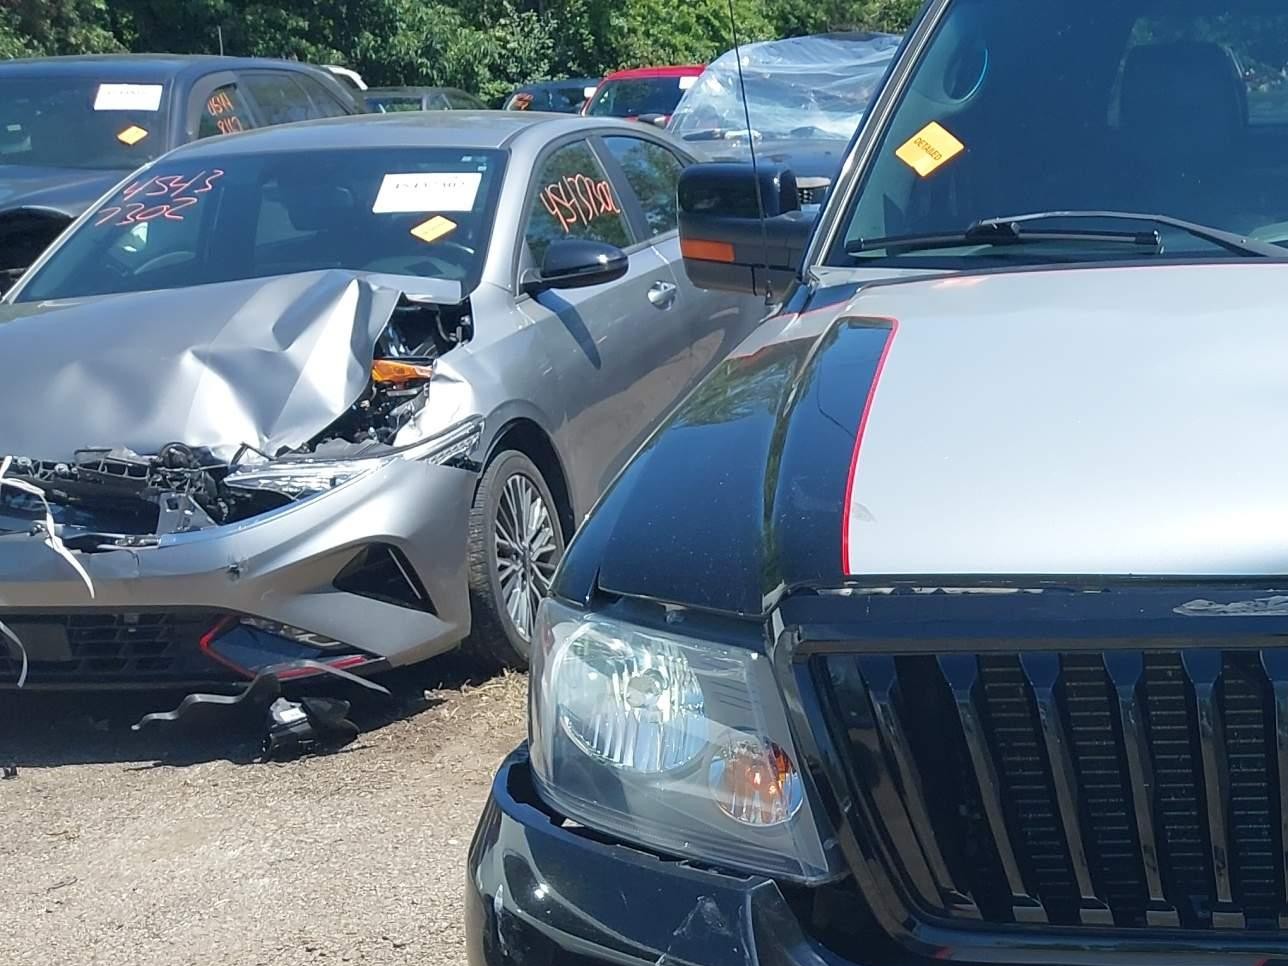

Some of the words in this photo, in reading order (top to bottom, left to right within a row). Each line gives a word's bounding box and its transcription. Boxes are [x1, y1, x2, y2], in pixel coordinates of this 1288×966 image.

[913, 137, 943, 161] DETAILED
[123, 169, 224, 200] 4543
[95, 197, 198, 226] 7302
